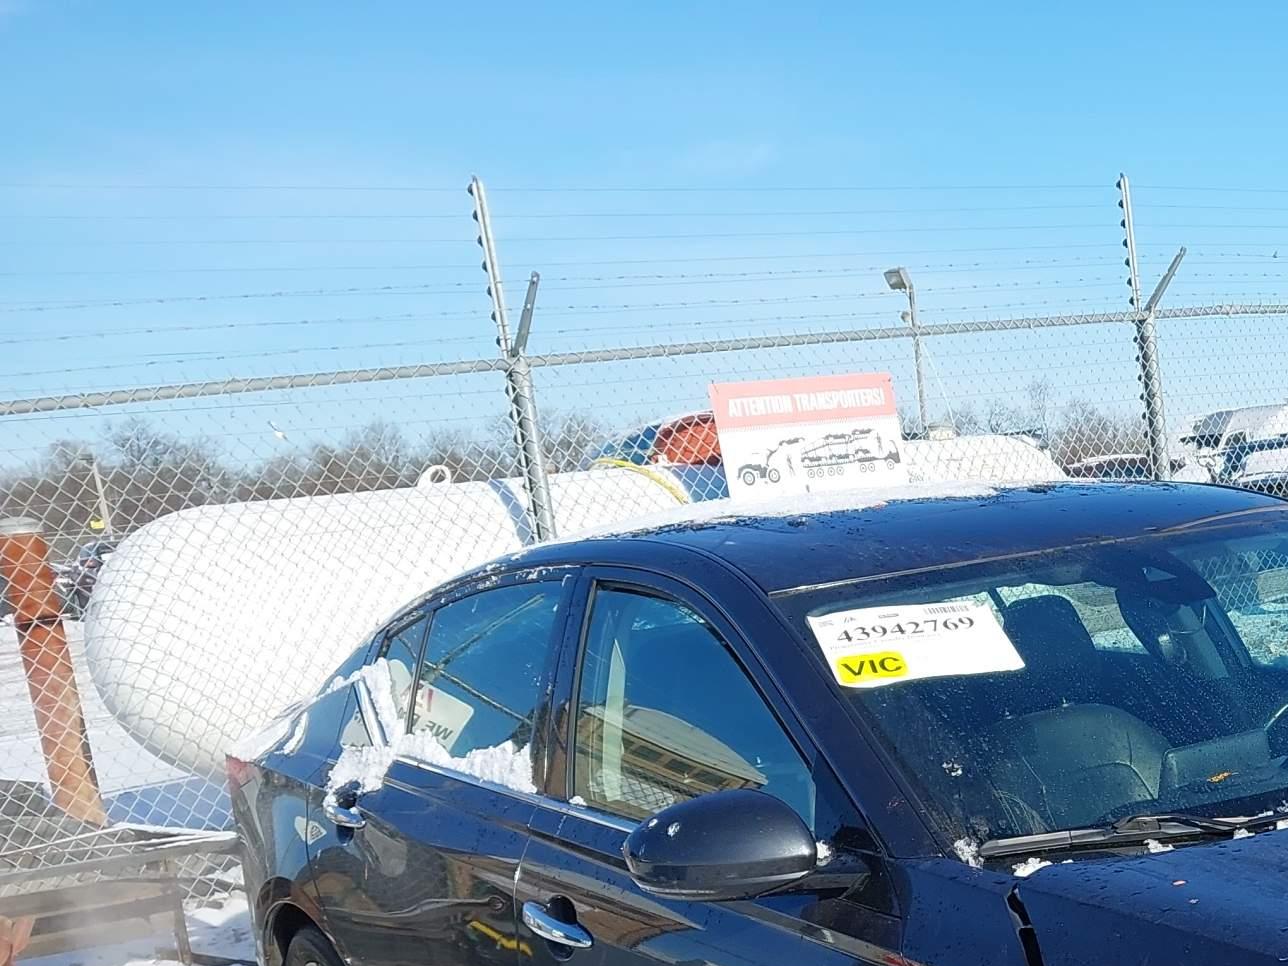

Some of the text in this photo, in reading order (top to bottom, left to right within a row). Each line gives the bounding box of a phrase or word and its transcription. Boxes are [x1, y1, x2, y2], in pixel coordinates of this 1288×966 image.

[728, 388, 885, 417] ATTENTION TRANSPORTERS!
[837, 616, 975, 643] 43942769
[841, 656, 903, 677] VIC
